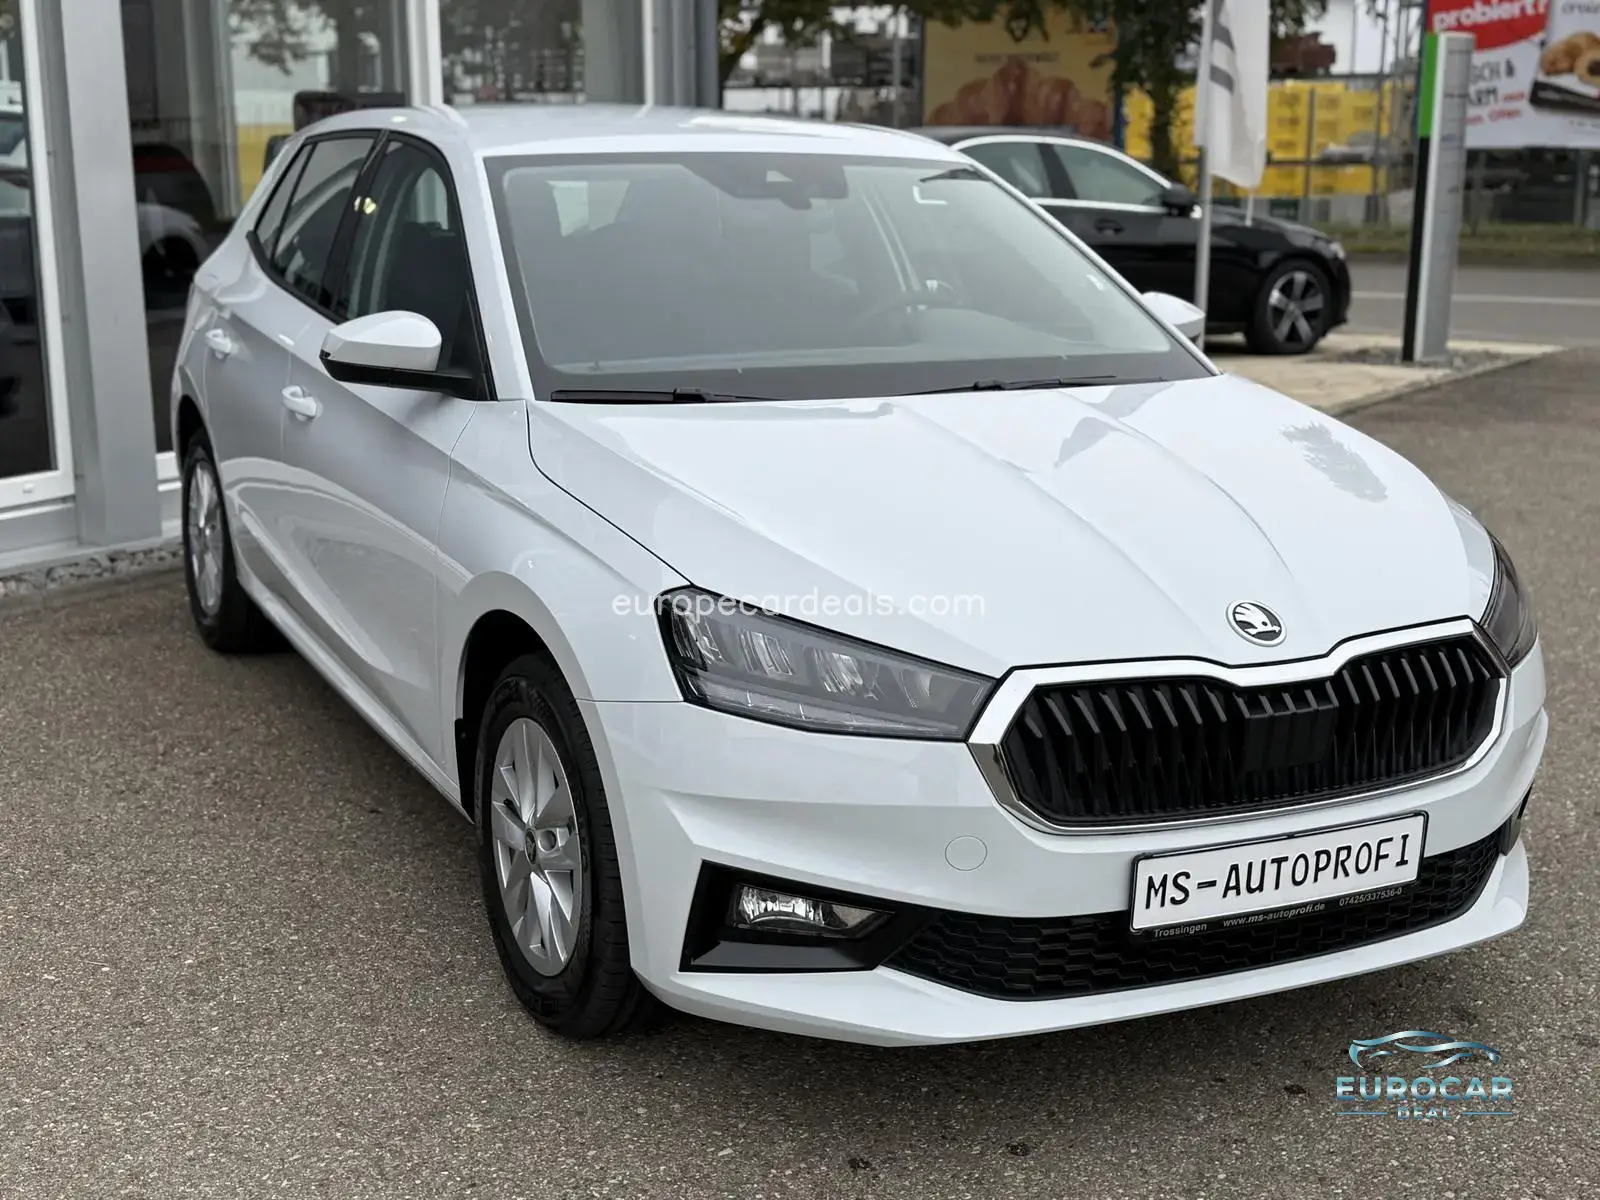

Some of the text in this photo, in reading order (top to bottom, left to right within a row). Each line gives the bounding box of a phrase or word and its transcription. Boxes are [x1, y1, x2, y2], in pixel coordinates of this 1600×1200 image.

[1145, 834, 1409, 909] MS-AUTOPROFI
[1154, 923, 1207, 937] Trossingen
[1223, 903, 1326, 927] www.ms-autoprofi.de
